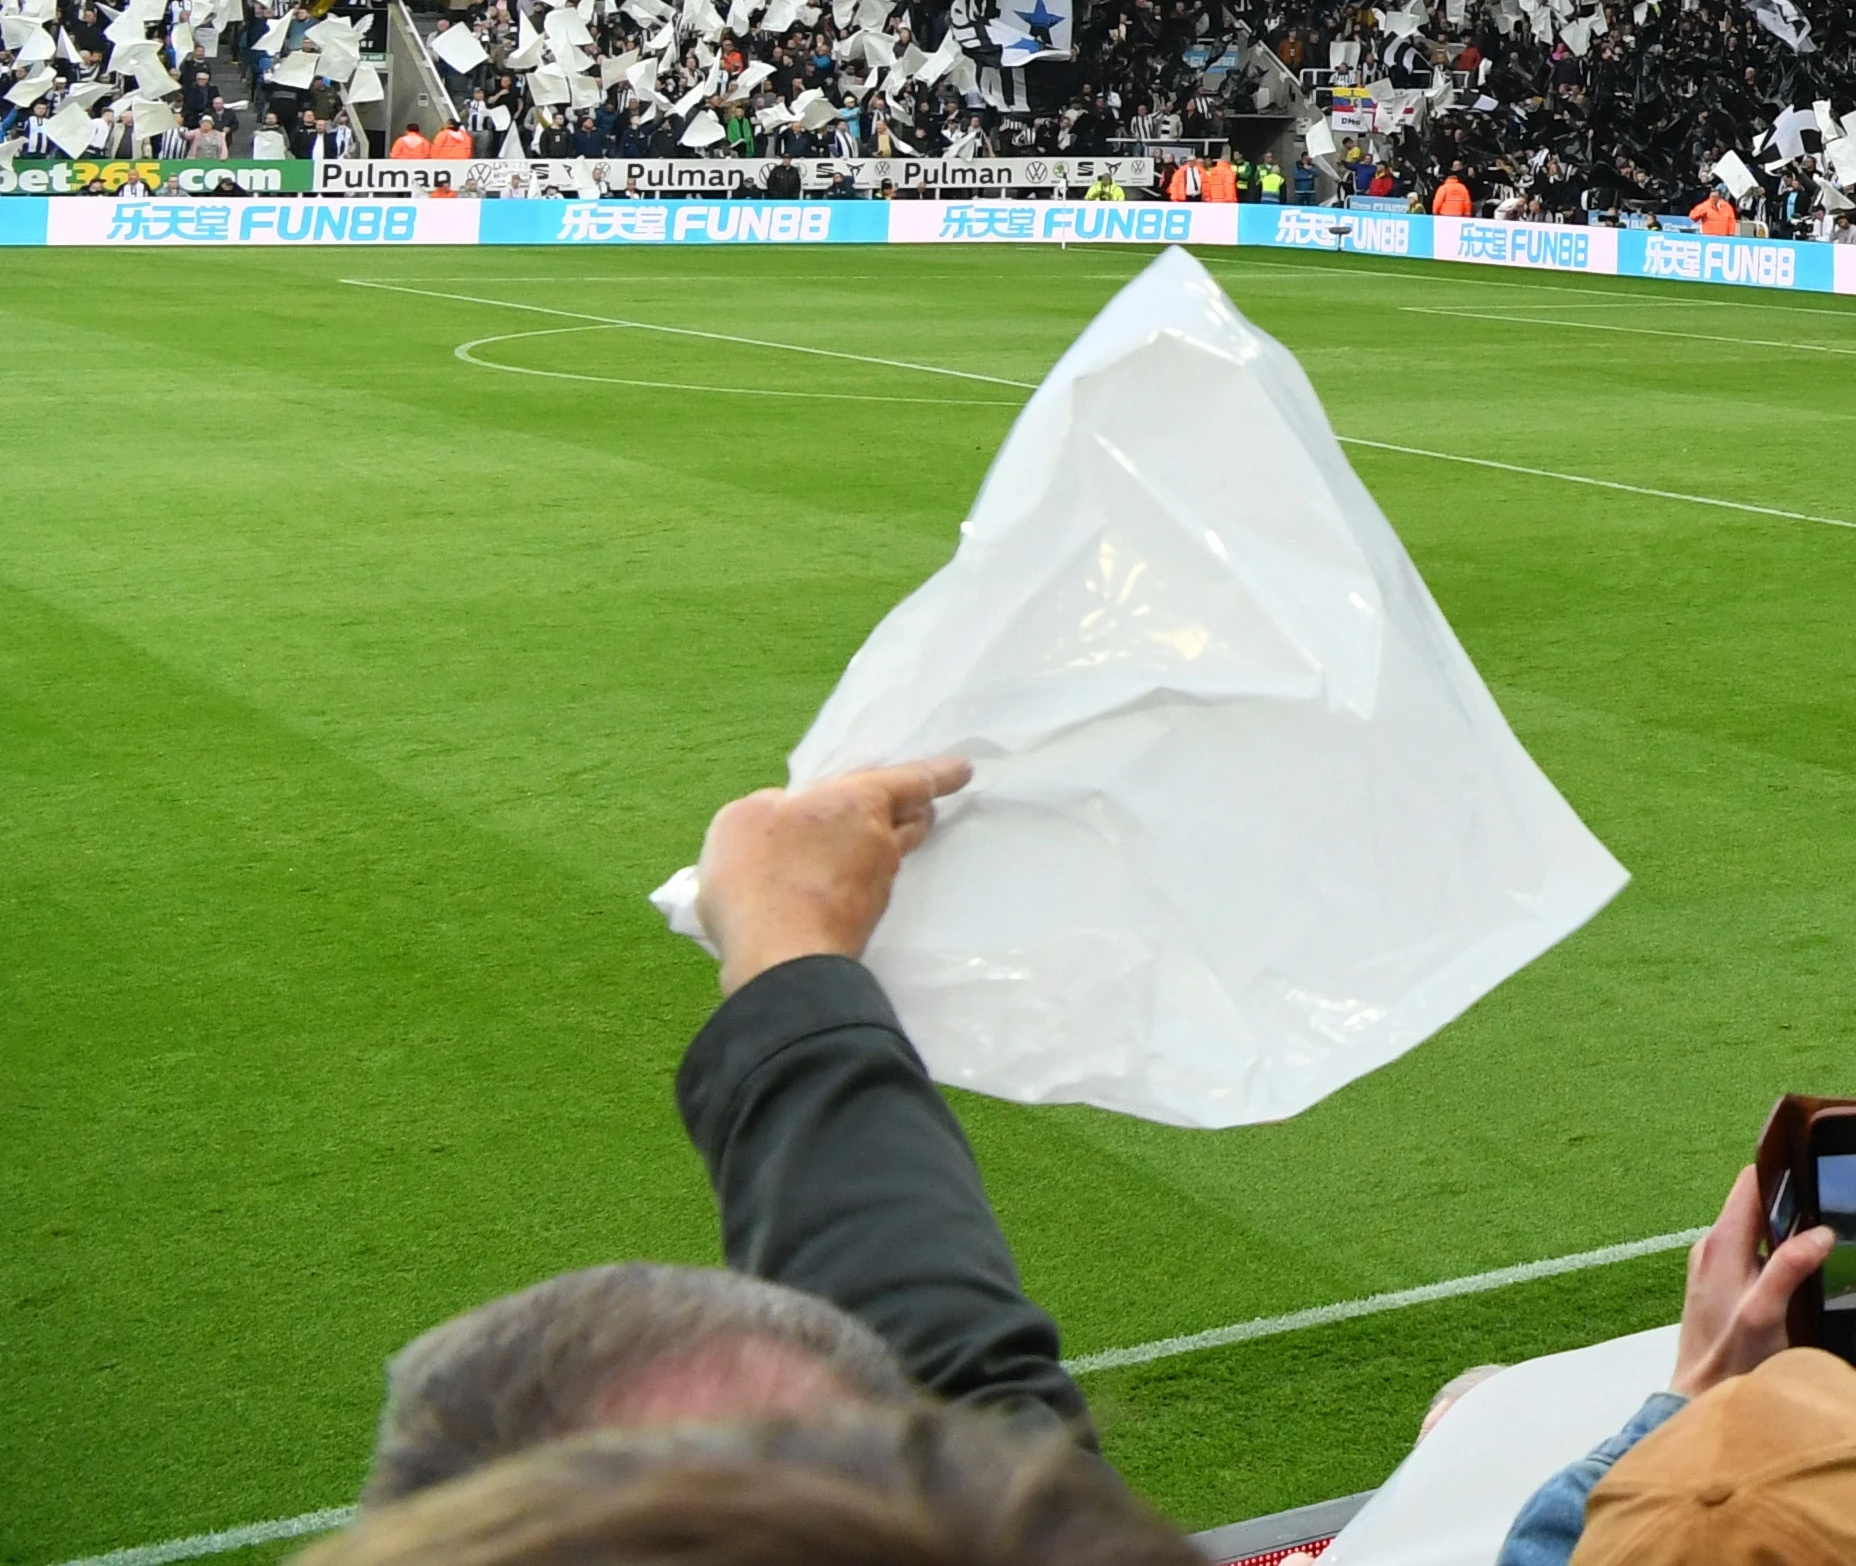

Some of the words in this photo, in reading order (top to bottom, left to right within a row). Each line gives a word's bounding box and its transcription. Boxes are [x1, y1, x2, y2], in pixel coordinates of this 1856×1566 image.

[323, 163, 451, 188] Pulman
[627, 163, 745, 188] Pulman
[904, 162, 1012, 185] Pulman
[239, 206, 417, 240] FUN88
[673, 206, 832, 240] FUN88
[1043, 208, 1192, 240] FUN88
[1340, 215, 1409, 255] FUN88
[1511, 229, 1589, 268] FUN88
[1704, 242, 1796, 287] FUN88
